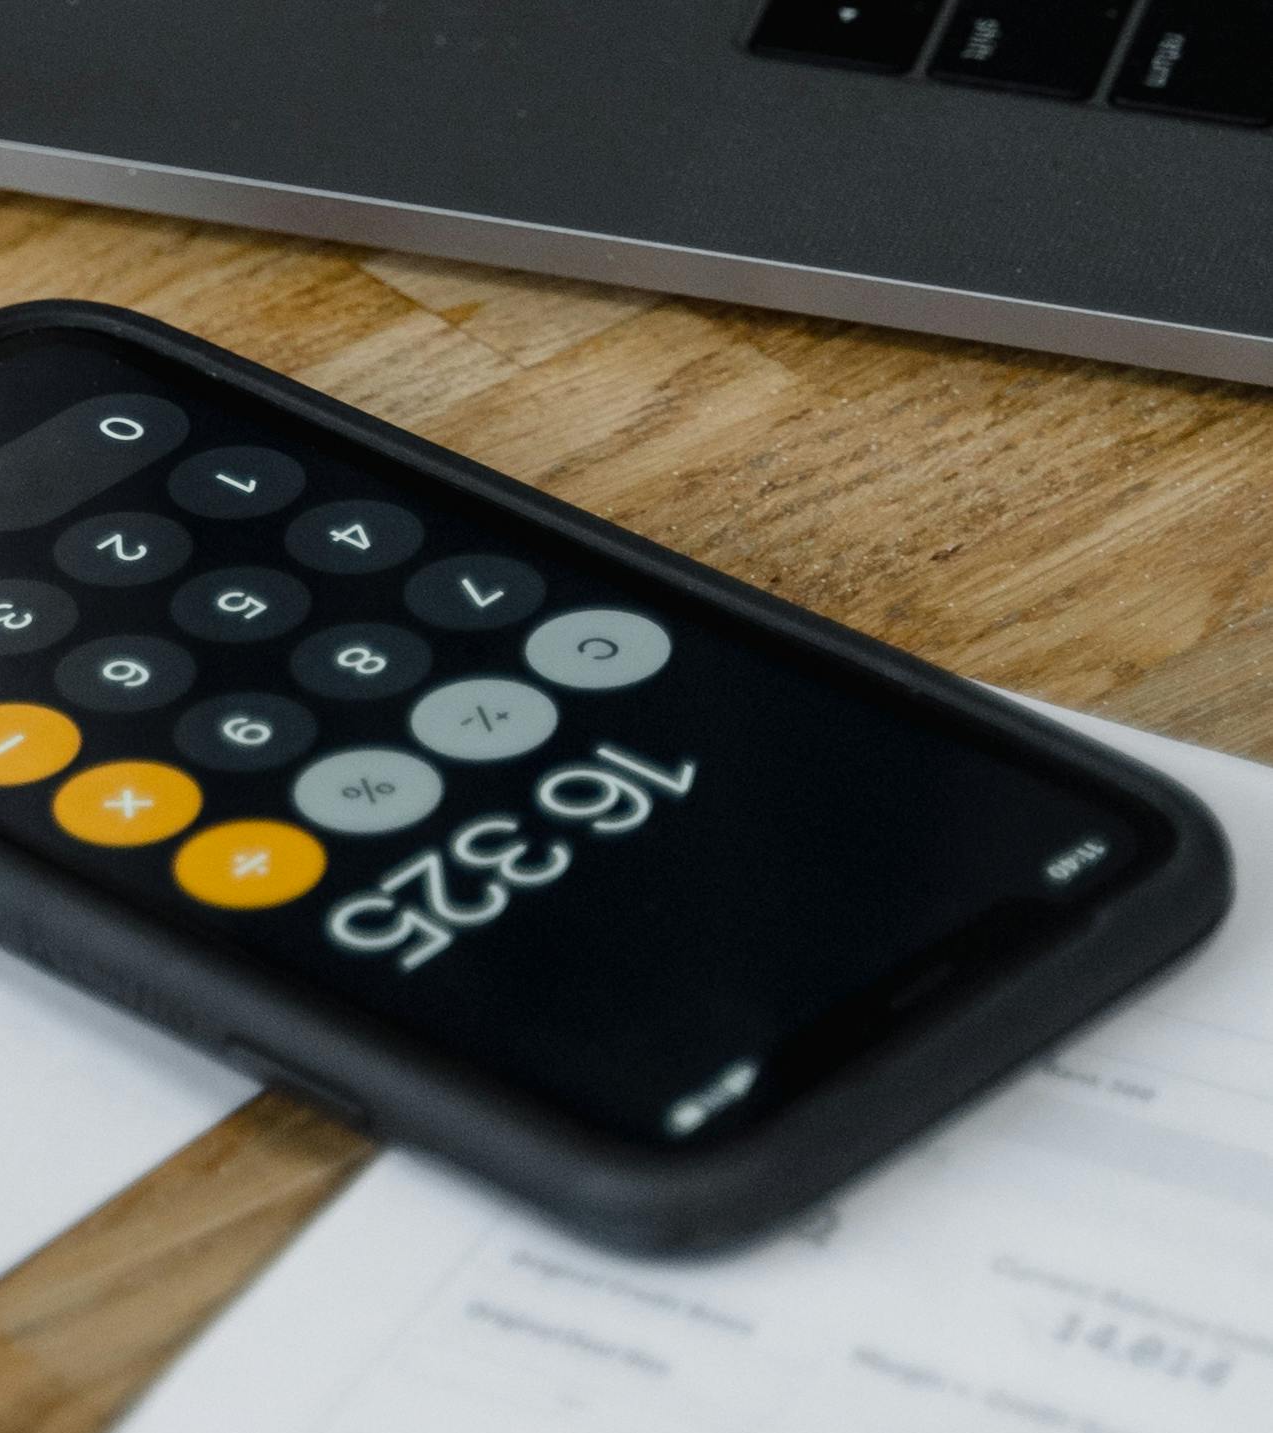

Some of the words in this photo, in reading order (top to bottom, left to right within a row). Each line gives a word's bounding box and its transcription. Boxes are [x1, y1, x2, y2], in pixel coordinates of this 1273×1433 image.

[98, 416, 145, 441] 0
[215, 473, 257, 494] 1
[96, 533, 148, 562] 2
[329, 523, 371, 551] 4
[216, 590, 268, 620] 5
[460, 577, 505, 608] 7
[336, 646, 387, 675] 8
[576, 636, 620, 661] C
[101, 659, 151, 688] 6
[221, 716, 272, 746] 9
[340, 777, 397, 805] %
[553, 745, 696, 855] 16
[323, 809, 579, 970] 325
